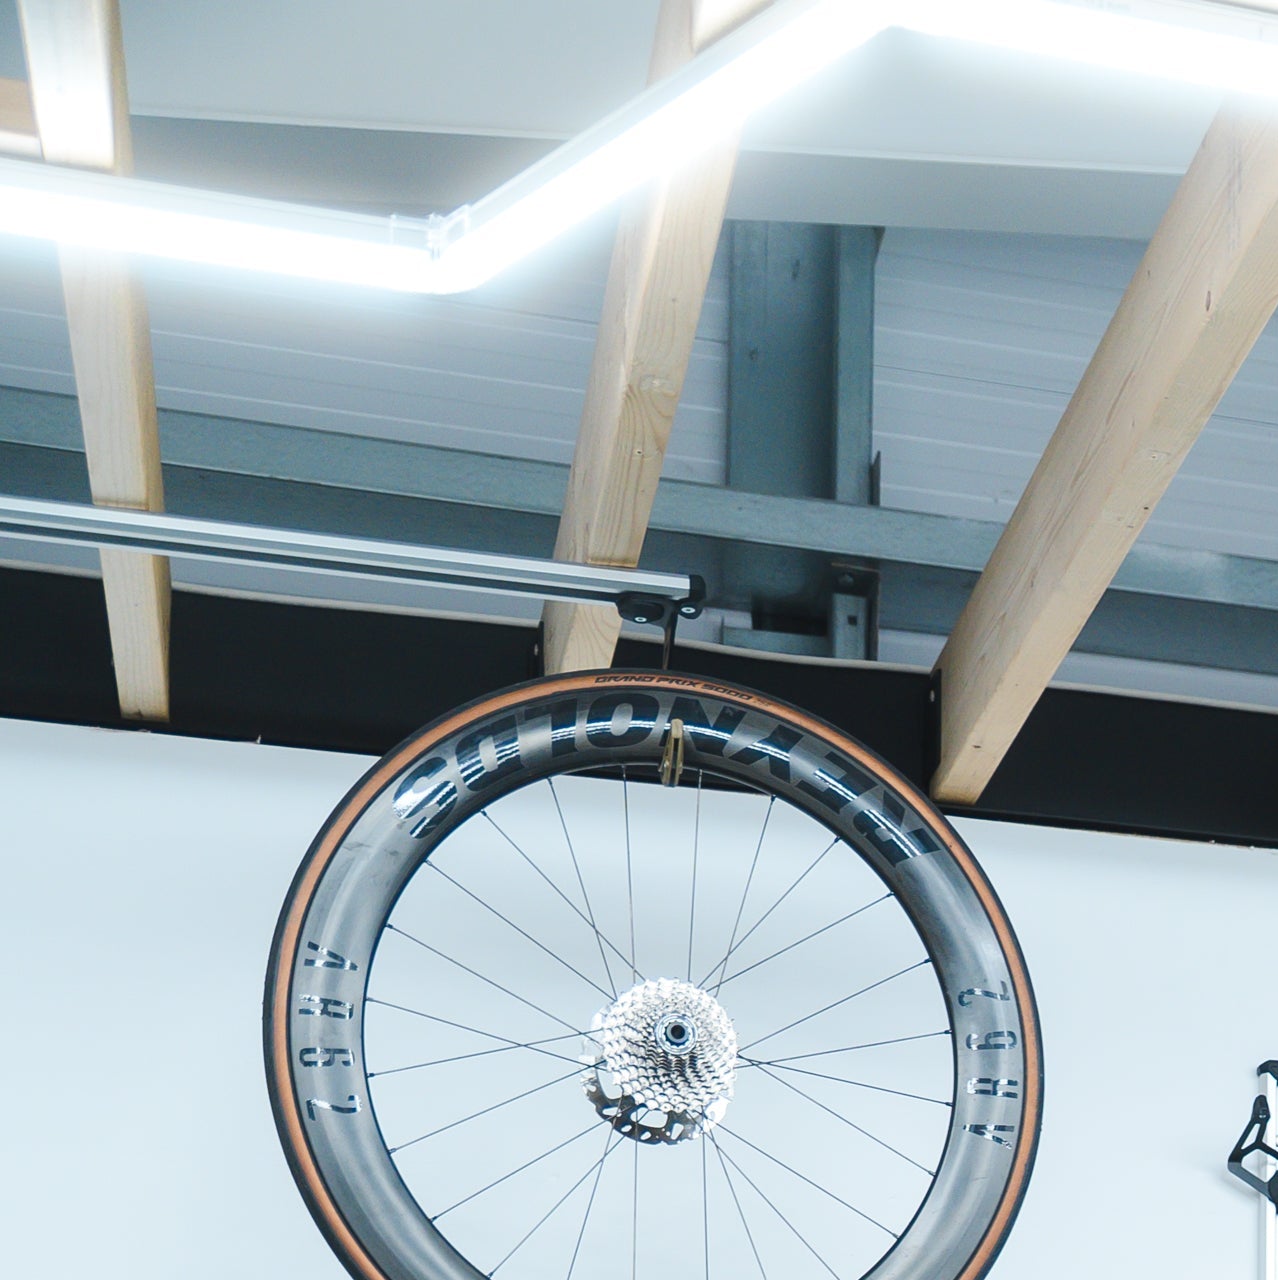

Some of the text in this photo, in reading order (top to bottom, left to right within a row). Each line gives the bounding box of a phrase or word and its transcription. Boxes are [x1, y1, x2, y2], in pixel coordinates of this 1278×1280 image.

[594, 675, 753, 701] GRAND PRIX 5000
[393, 692, 942, 869] REYNOLDS
